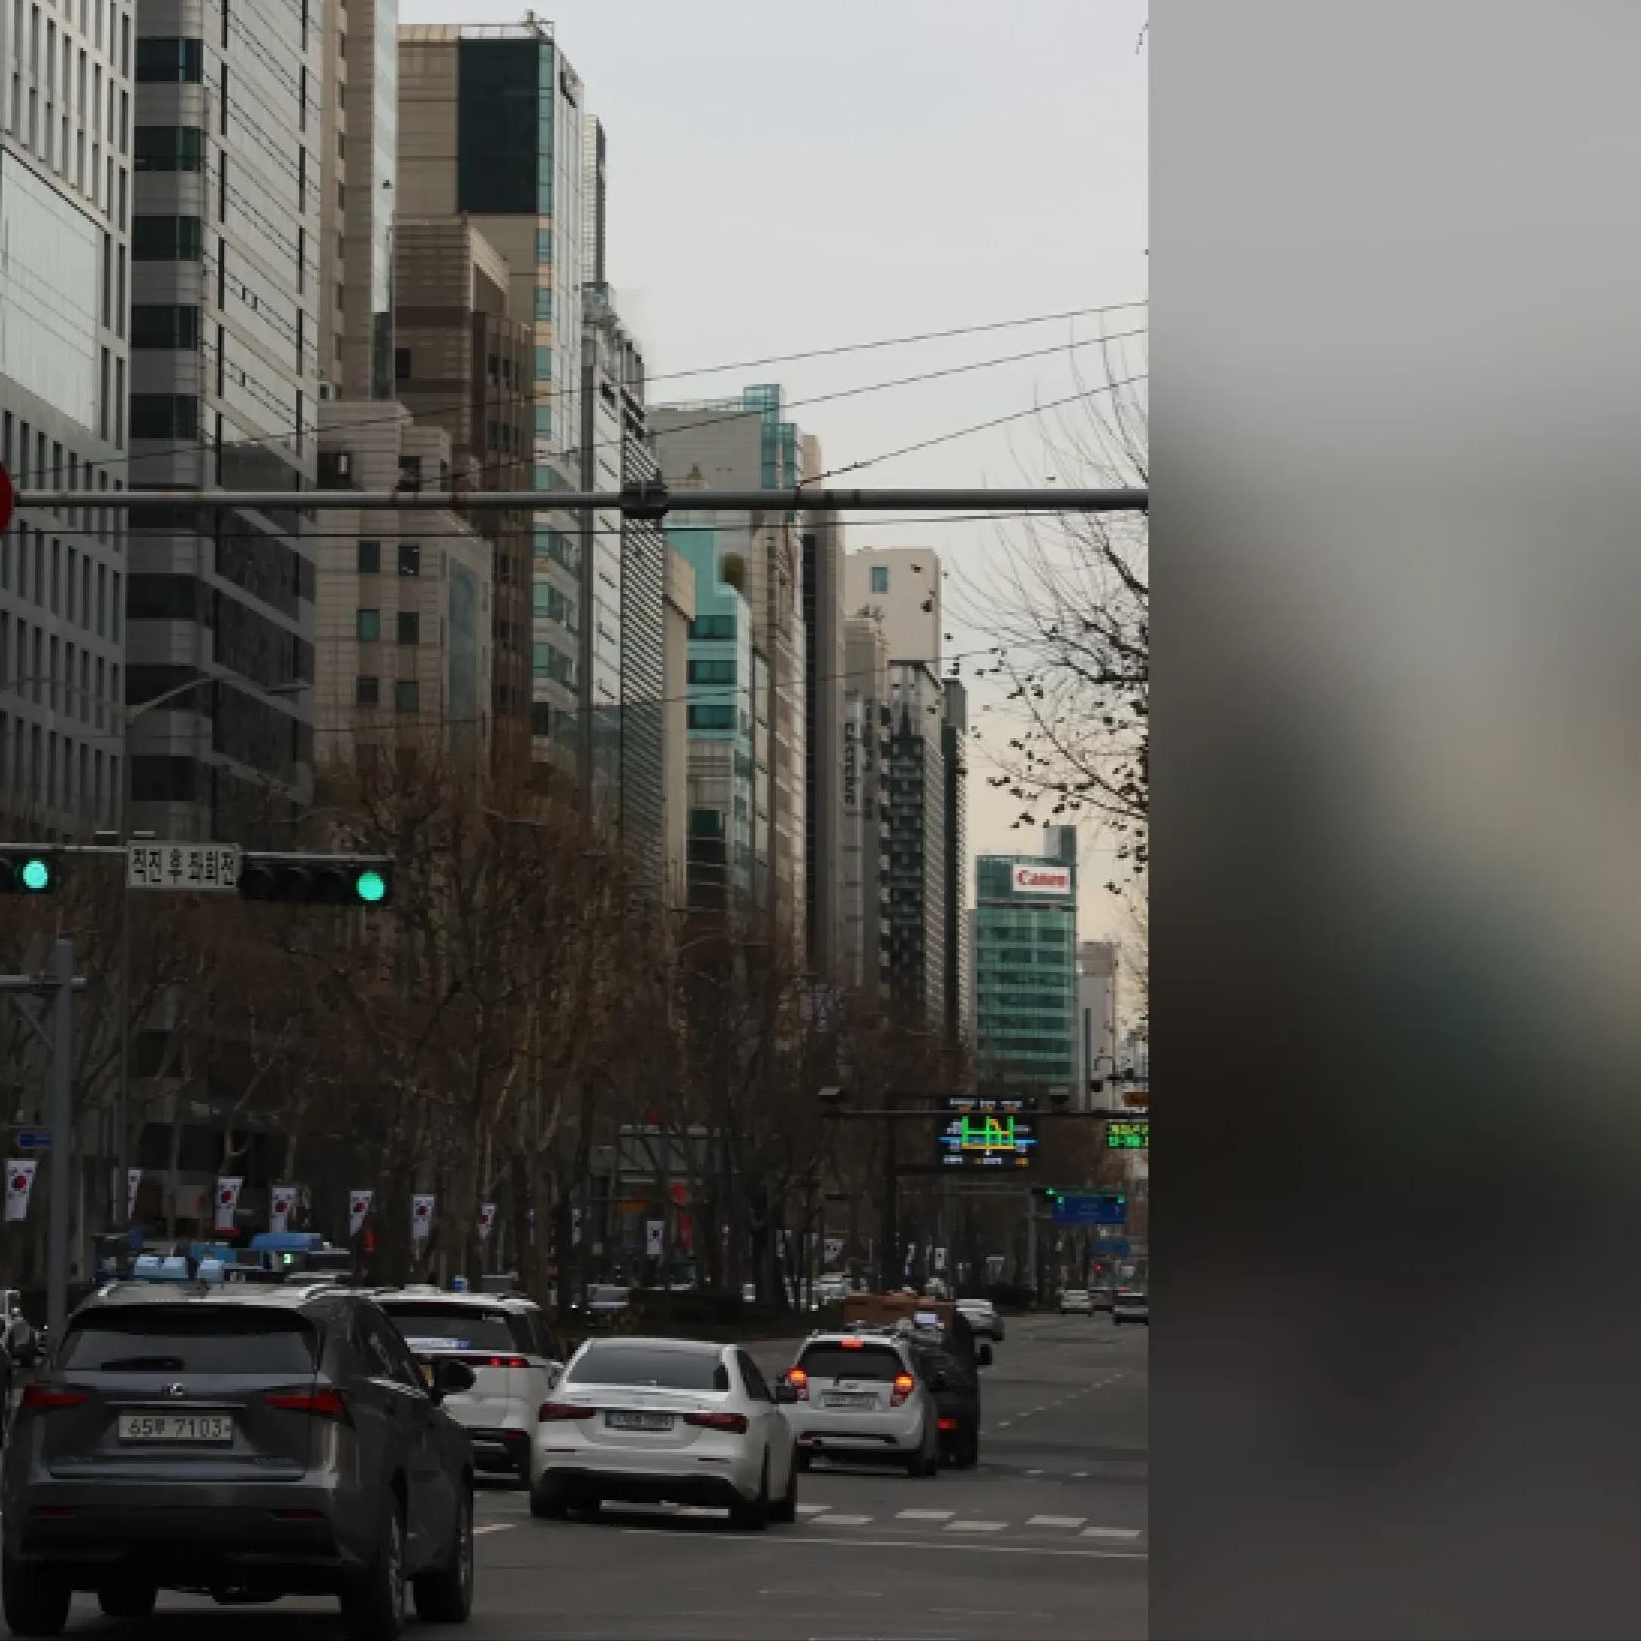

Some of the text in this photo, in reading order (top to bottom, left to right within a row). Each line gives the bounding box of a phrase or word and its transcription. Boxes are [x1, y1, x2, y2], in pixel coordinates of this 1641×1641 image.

[134, 848, 162, 882] 직진
[187, 850, 235, 885] 좌회전
[173, 1417, 222, 1438] 7103
